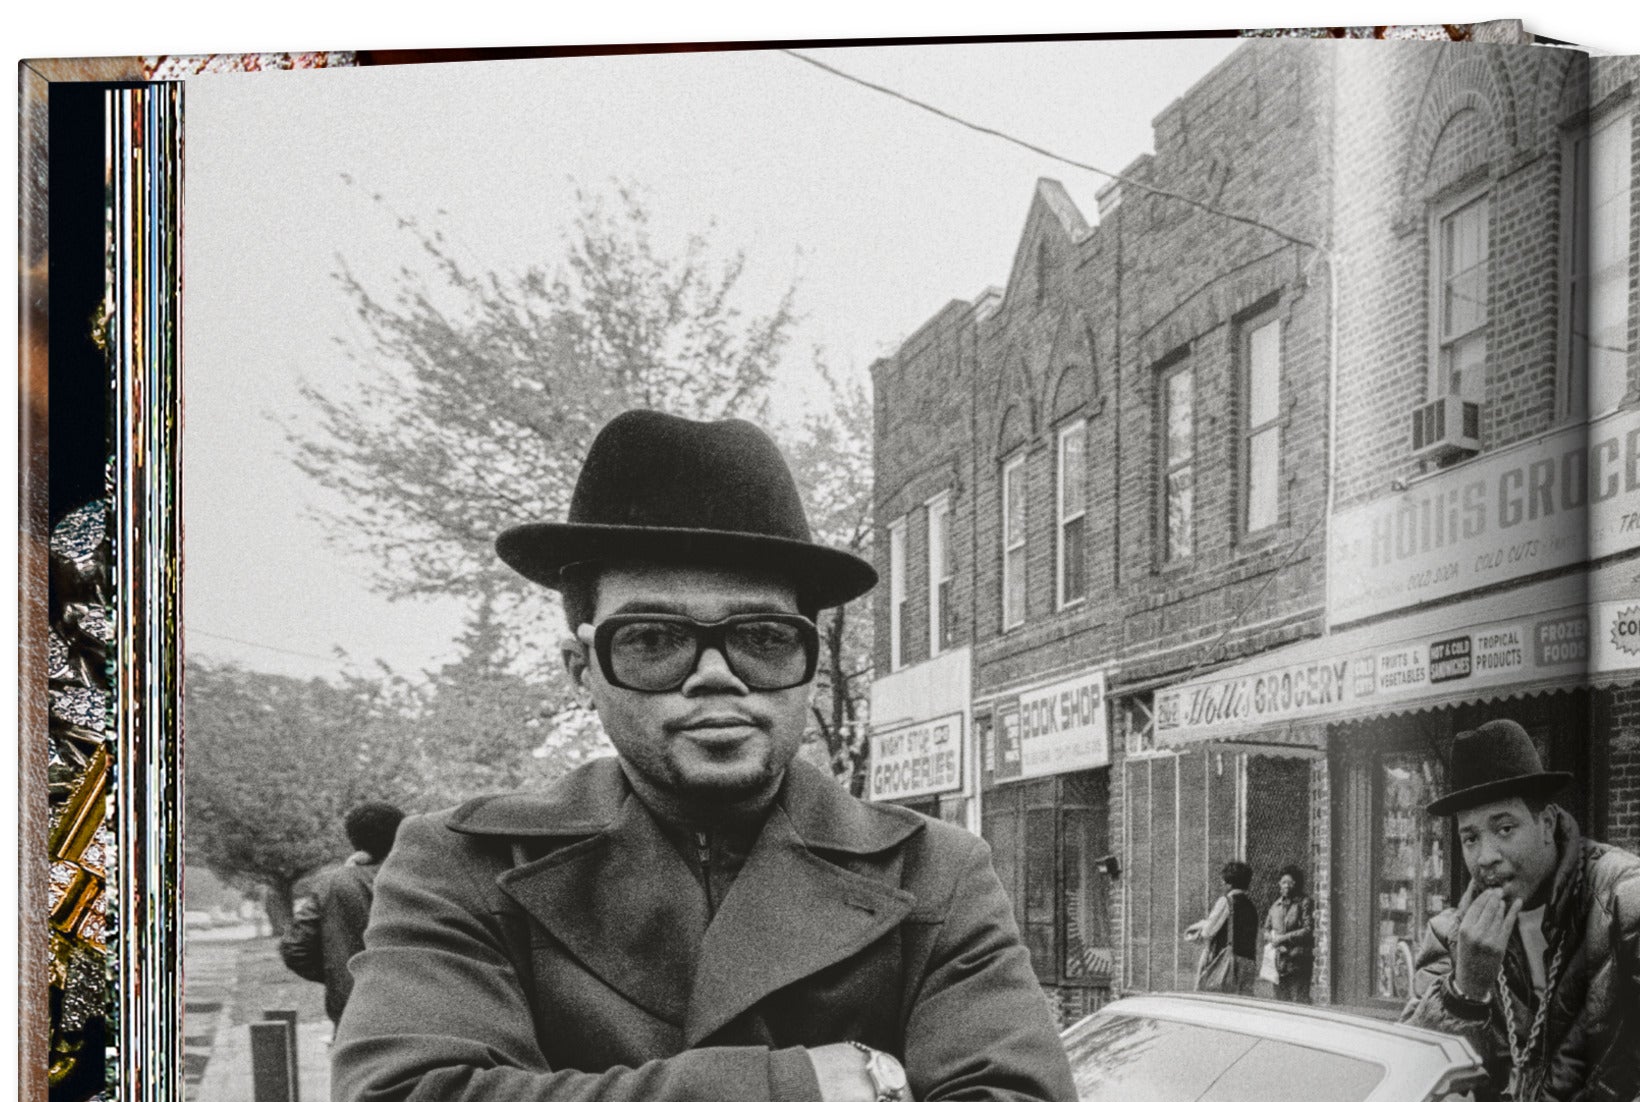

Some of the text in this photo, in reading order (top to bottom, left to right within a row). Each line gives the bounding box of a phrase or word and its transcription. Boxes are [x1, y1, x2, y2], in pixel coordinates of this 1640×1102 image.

[1509, 540, 1539, 564] CUTS
[1478, 631, 1519, 654] TROPICAL
[1541, 619, 1586, 643] FROZE
[1476, 648, 1522, 669] PRODUCTS
[1544, 640, 1586, 662] FOODS
[1255, 661, 1348, 714] GROCERY
[1381, 667, 1425, 687] VEGETABLES
[1023, 684, 1100, 739] BOOK SHOP
[874, 750, 956, 796] GROCERIES
